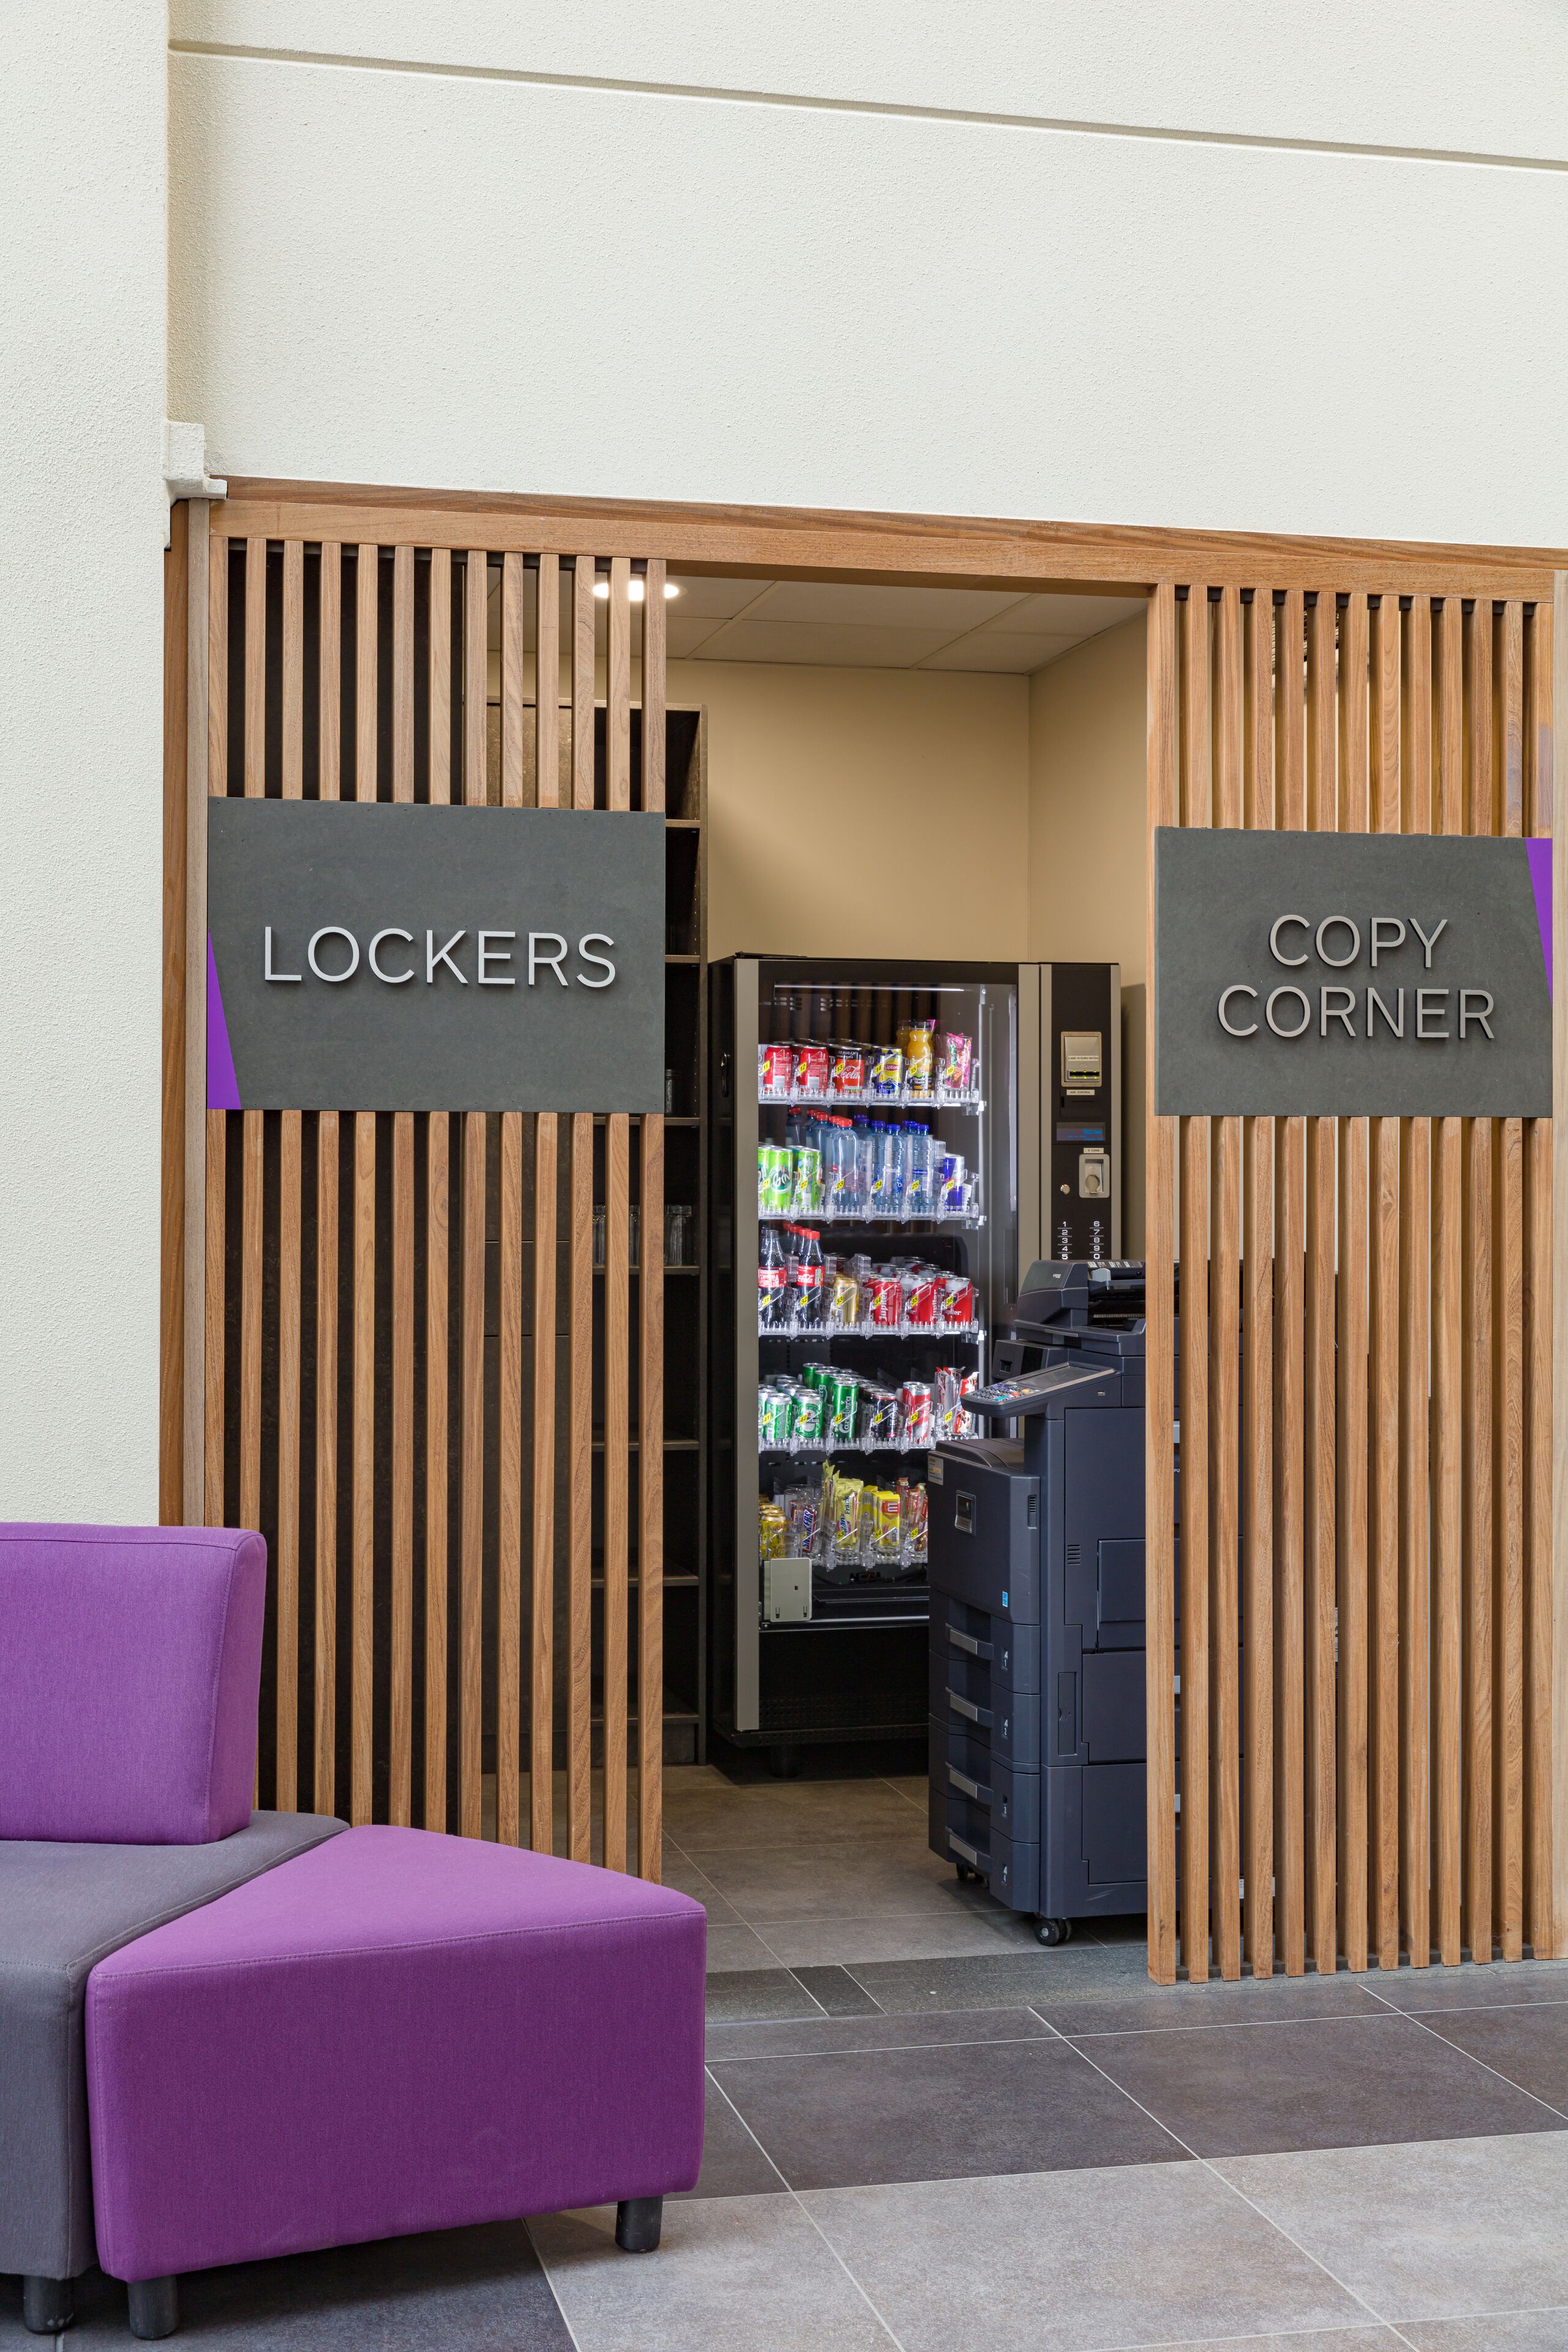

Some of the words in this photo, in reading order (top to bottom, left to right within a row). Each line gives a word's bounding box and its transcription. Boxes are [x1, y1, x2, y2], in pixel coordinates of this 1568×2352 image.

[264, 925, 617, 989] LOCKERS
[1268, 914, 1449, 968] COPY
[1218, 984, 1494, 1039] CORNER
[887, 1502, 899, 1512] LU
